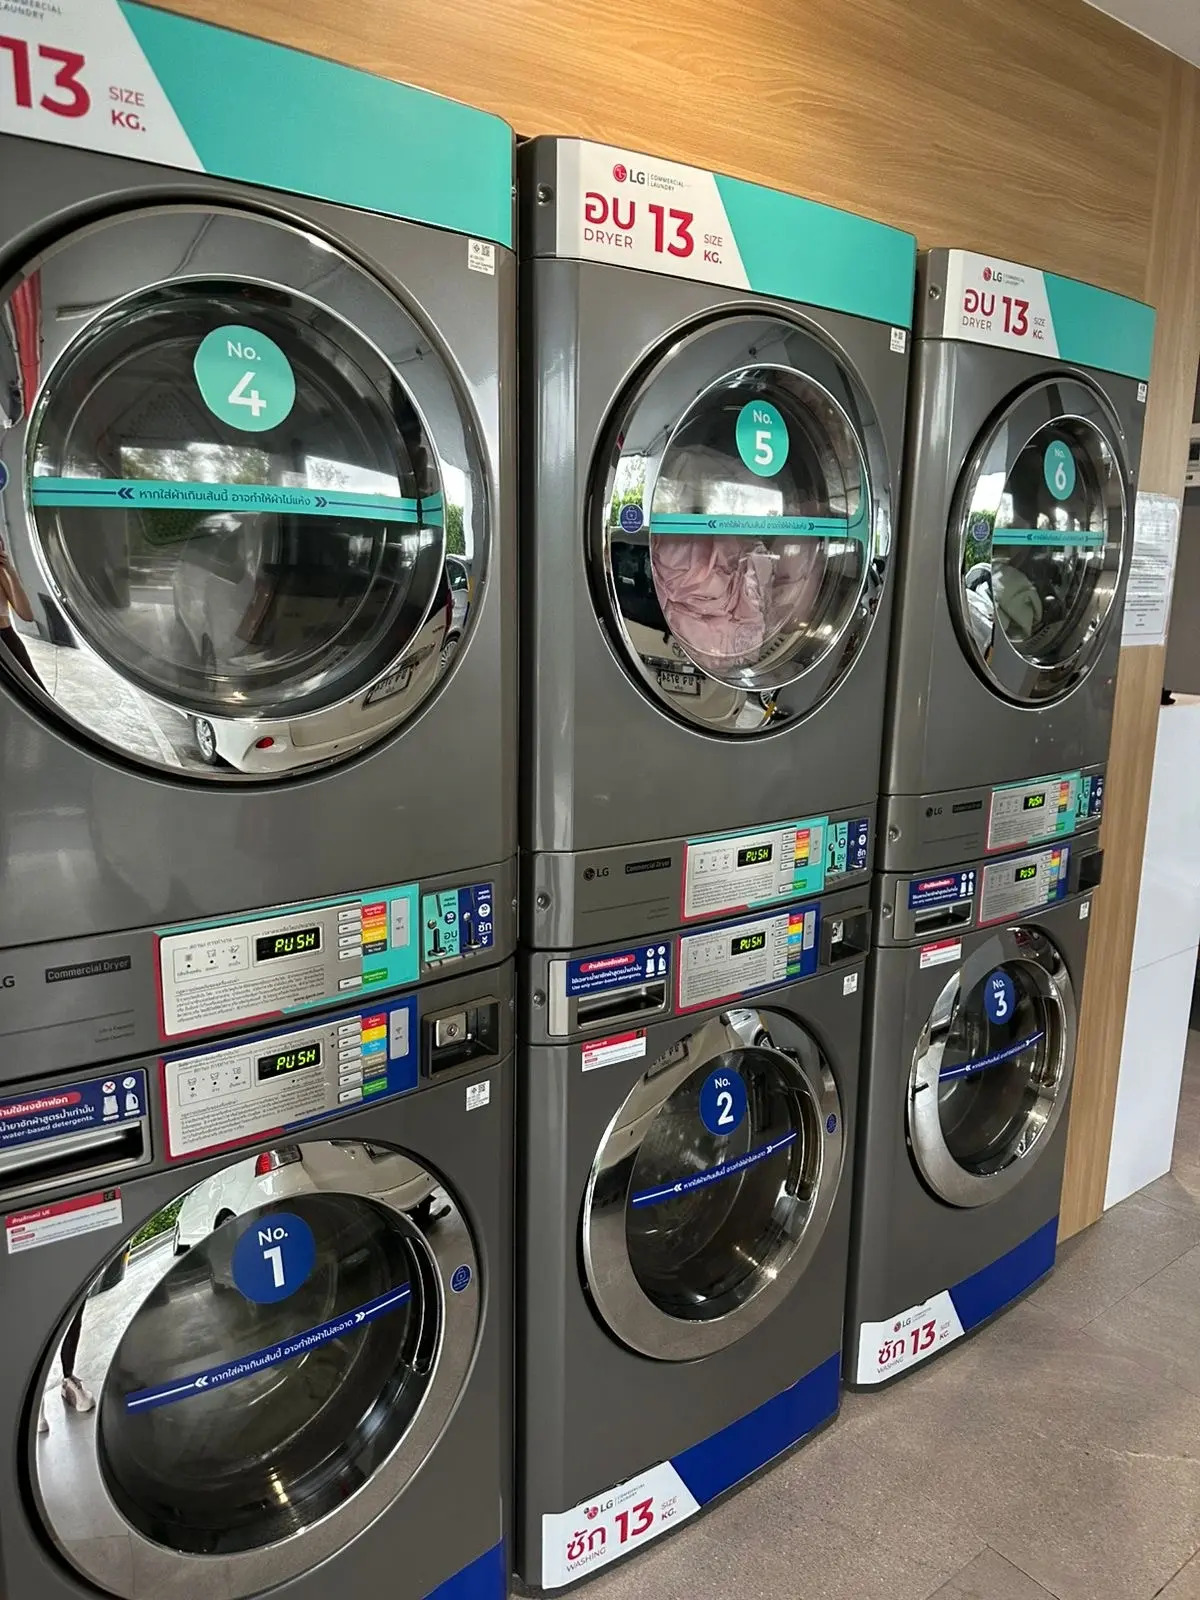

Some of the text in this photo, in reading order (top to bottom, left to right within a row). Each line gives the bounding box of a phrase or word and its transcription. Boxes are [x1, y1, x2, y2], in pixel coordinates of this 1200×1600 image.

[0, 35, 91, 118] 13
[109, 86, 145, 107] SIZE
[111, 109, 146, 132] KG.
[629, 169, 645, 185] LG
[585, 191, 695, 258] อบ 13
[584, 228, 633, 249] DRYER
[703, 234, 723, 247] SIZE
[703, 249, 723, 265] KG.
[992, 270, 1003, 283] LG
[963, 288, 1030, 337] อบ 13
[962, 315, 992, 331] DRYER
[1033, 317, 1046, 328] SIZE
[227, 340, 262, 361] No.
[227, 371, 267, 417] 4
[752, 409, 773, 425] No.
[754, 430, 774, 466] 5
[1055, 461, 1067, 491] 6
[1028, 796, 1044, 806] PUSH
[934, 808, 943, 816] LG
[745, 848, 769, 862] PUSH
[597, 868, 609, 878] LG
[1020, 866, 1036, 878] PUSH
[274, 932, 315, 953] PUSH
[739, 935, 763, 950] PUSH
[47, 960, 129, 980] Commercial Dryer
[0, 975, 15, 989] G
[994, 990, 1008, 1017] 3
[276, 1049, 316, 1071] PUSH
[714, 1077, 731, 1090] No.
[717, 1091, 735, 1126] 2
[2, 1115, 95, 1140] water-based detergents.
[258, 1227, 289, 1246] No.
[263, 1246, 285, 1288] 1
[902, 1317, 911, 1328] LG
[878, 1319, 937, 1365] ซัก 13
[600, 1499, 614, 1513] LG
[660, 1496, 677, 1510] SIZE
[661, 1508, 677, 1521] KG.
[566, 1496, 654, 1561] ซัก 13
[566, 1546, 606, 1572] WASHING
